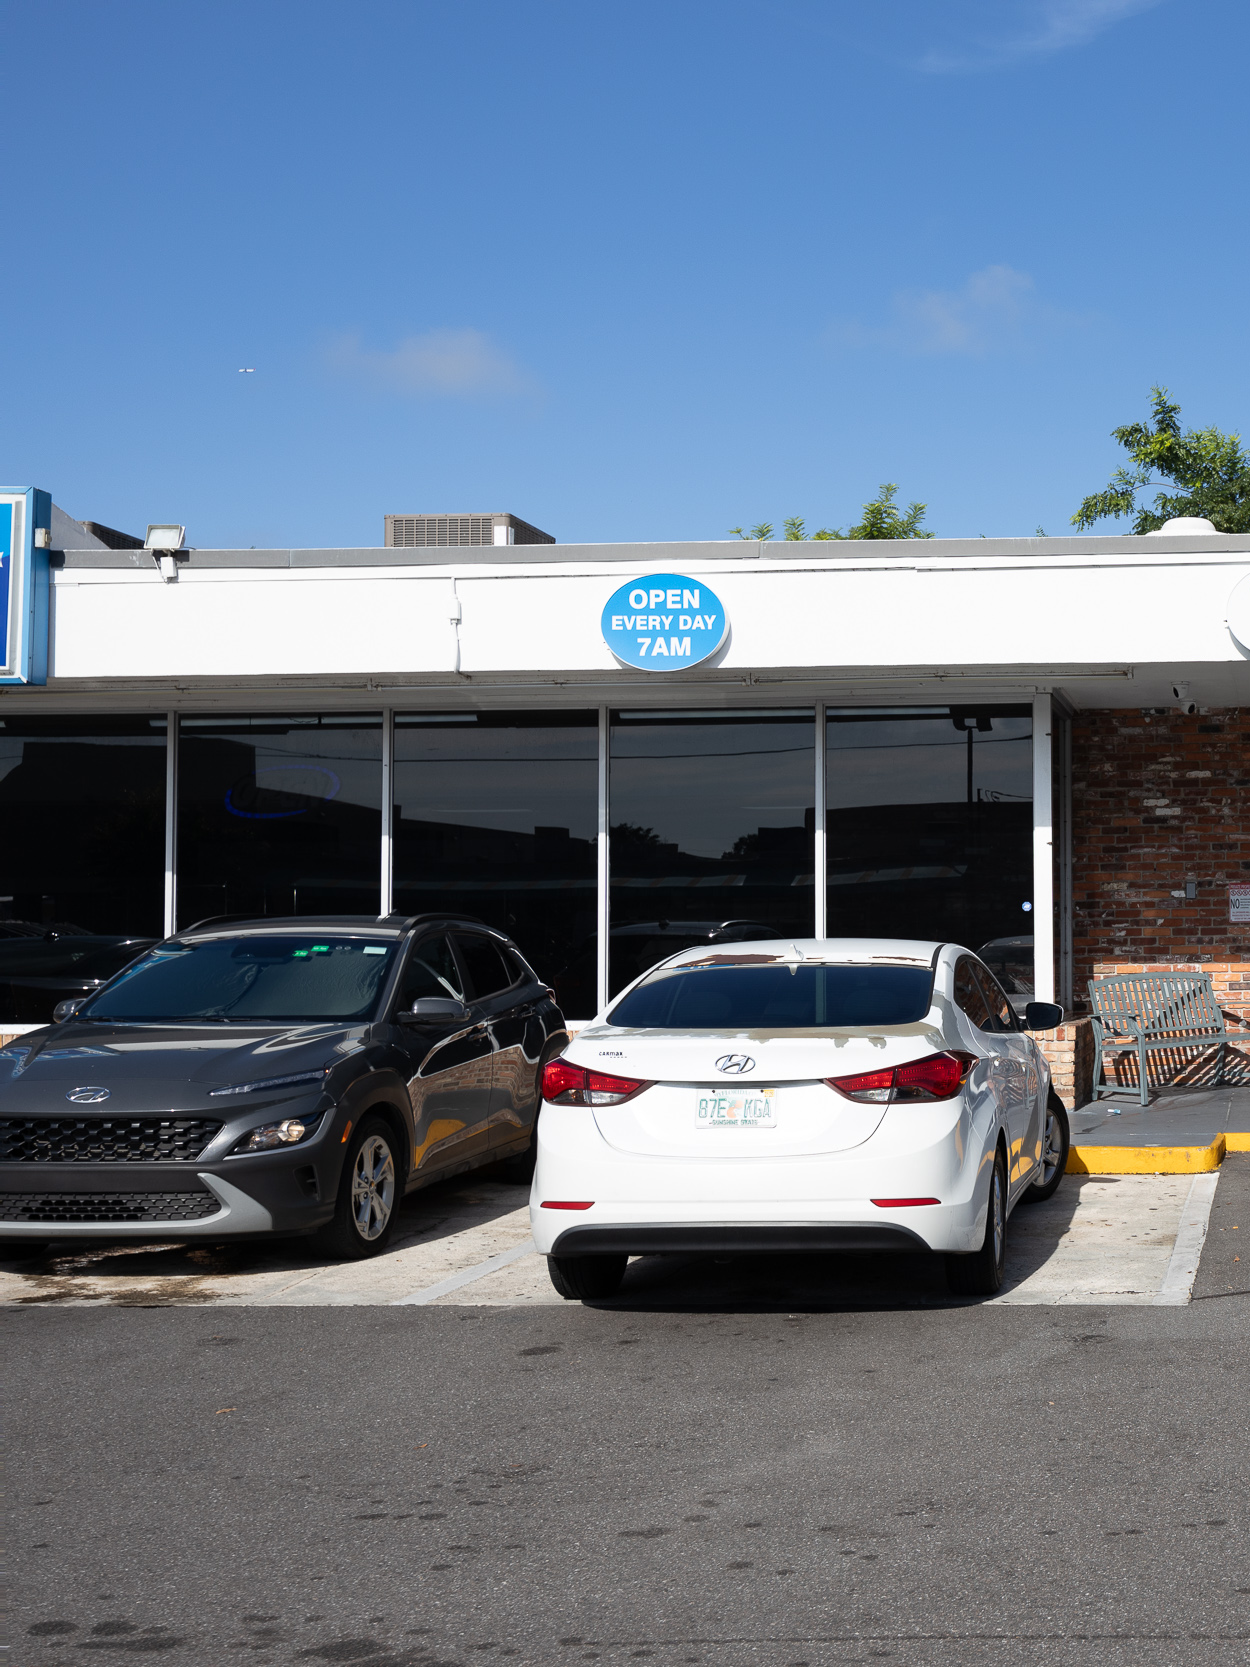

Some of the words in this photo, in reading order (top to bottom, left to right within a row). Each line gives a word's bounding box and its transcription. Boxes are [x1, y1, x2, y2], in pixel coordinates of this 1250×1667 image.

[628, 588, 700, 610] OPEN
[611, 615, 674, 631] EVERY
[678, 614, 717, 631] DAY
[636, 637, 691, 657] 7AM
[1231, 898, 1240, 909] NO
[743, 1098, 771, 1118] KGA
